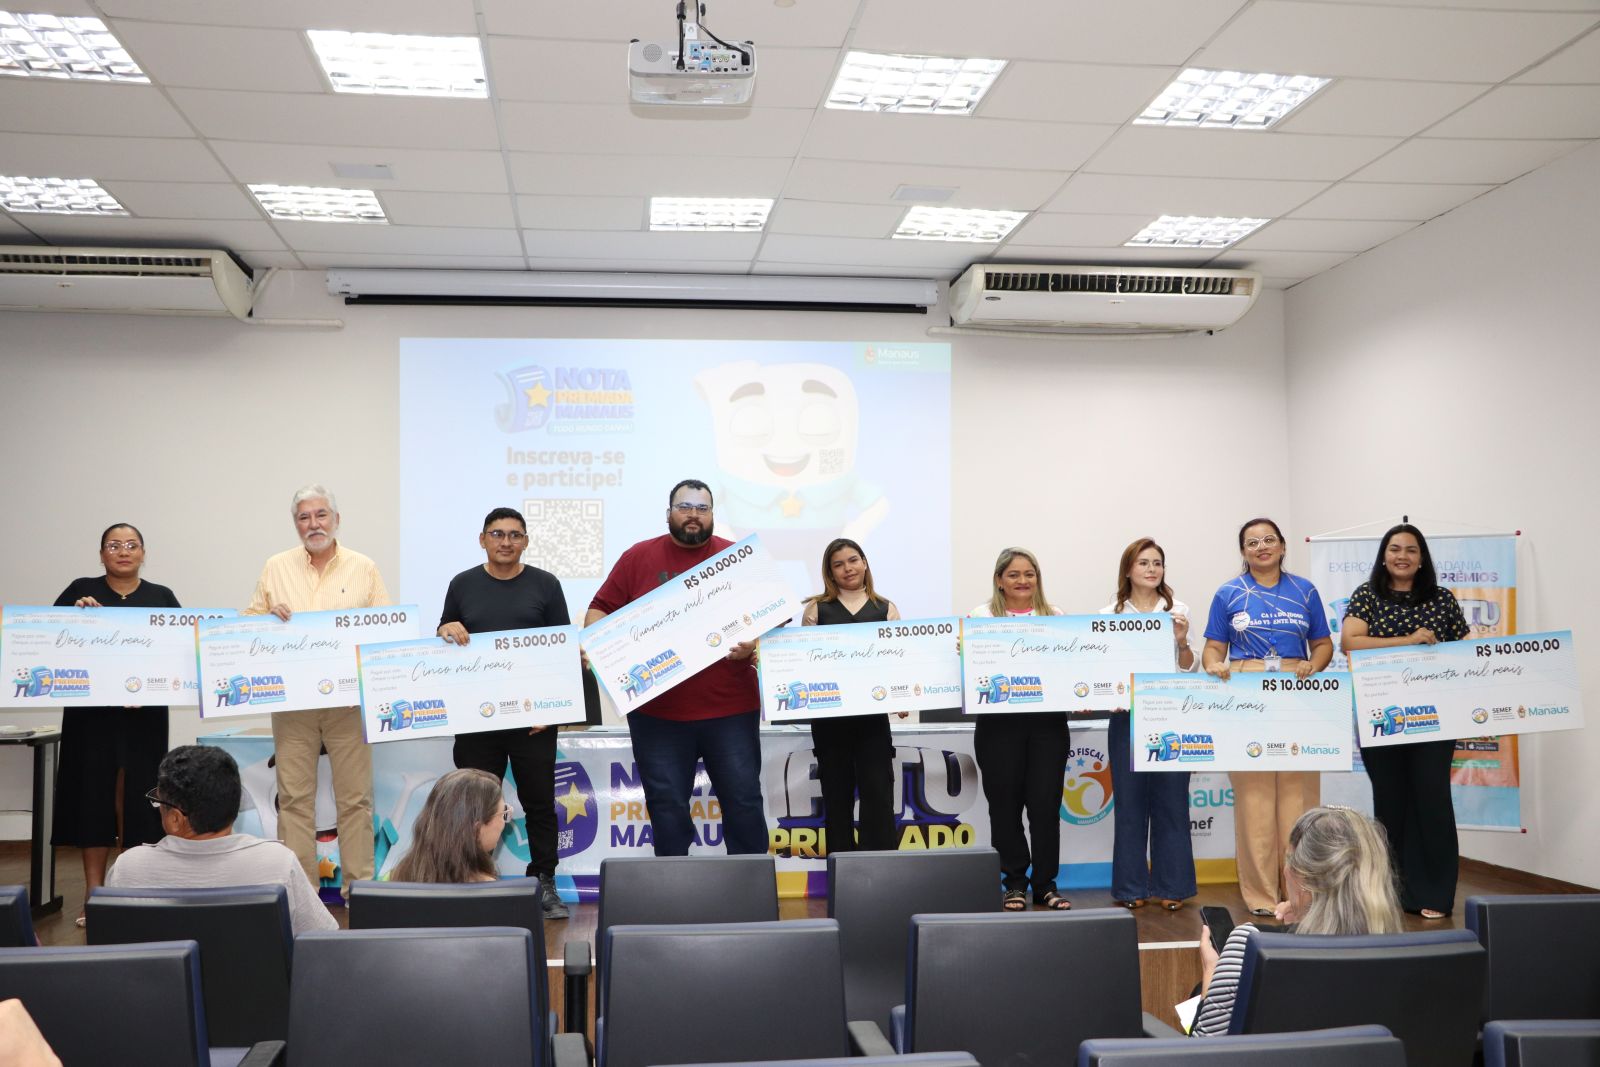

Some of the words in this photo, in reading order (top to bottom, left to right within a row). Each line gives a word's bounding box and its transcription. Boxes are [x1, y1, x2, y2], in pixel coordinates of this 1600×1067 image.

[555, 367, 632, 390] NOTA
[507, 446, 625, 465] Inscreva-se
[507, 472, 518, 487] e
[523, 467, 623, 491] participe!
[684, 575, 700, 590] R$
[699, 544, 754, 581] 40.000,00
[1437, 559, 1482, 570] ADANIA
[1440, 571, 1498, 583] PRÊMIOS
[629, 608, 680, 642] Quarenta
[684, 589, 704, 612] mil
[707, 580, 732, 600] reais
[752, 598, 786, 622] Manaus
[150, 614, 165, 627] R$
[336, 615, 350, 628] R$
[354, 612, 407, 626] 2.000,00
[1092, 620, 1106, 632] R$
[1110, 620, 1161, 632] 5.000,00
[56, 628, 84, 648] Dois
[90, 630, 120, 646] mil
[121, 636, 154, 647] reais
[878, 626, 892, 639] R$
[895, 623, 952, 637] 30.000,00
[250, 637, 277, 657] Dois
[282, 635, 310, 651] mil
[310, 640, 342, 650] reais
[495, 637, 510, 650] R$
[512, 632, 566, 648] 5.000,00
[1011, 638, 1048, 658] Cinco
[1052, 638, 1078, 652] mil
[1080, 644, 1110, 654] reais
[1476, 644, 1492, 657] R$
[1496, 638, 1560, 656] 40.000,00
[646, 649, 676, 668] NOTA
[806, 648, 846, 662] Trinta
[851, 644, 876, 658] mil
[877, 648, 906, 657] reais
[54, 669, 89, 679] NOTA
[412, 662, 452, 681] Cinco
[456, 656, 482, 672] mil
[484, 660, 515, 672] reais
[1401, 667, 1460, 686] Quarenta
[1464, 660, 1490, 678] mil
[1492, 665, 1524, 676] reais
[252, 676, 284, 685] NOTA
[808, 682, 838, 691] NOTA
[1011, 676, 1041, 686] NOTA
[1262, 680, 1276, 692] R$
[1280, 680, 1339, 692] 10.000,00
[924, 684, 960, 694] Manaus
[413, 699, 446, 710] NOTA
[534, 698, 572, 710] Manaus
[1182, 694, 1203, 714] Dez
[1208, 696, 1235, 711] mil
[1236, 702, 1267, 712] reais
[1404, 705, 1436, 716] NOTA
[1528, 705, 1569, 716] Manaus
[1182, 734, 1213, 744] NOTA
[1077, 748, 1104, 761] FISCAL
[1301, 745, 1340, 754] Manaus
